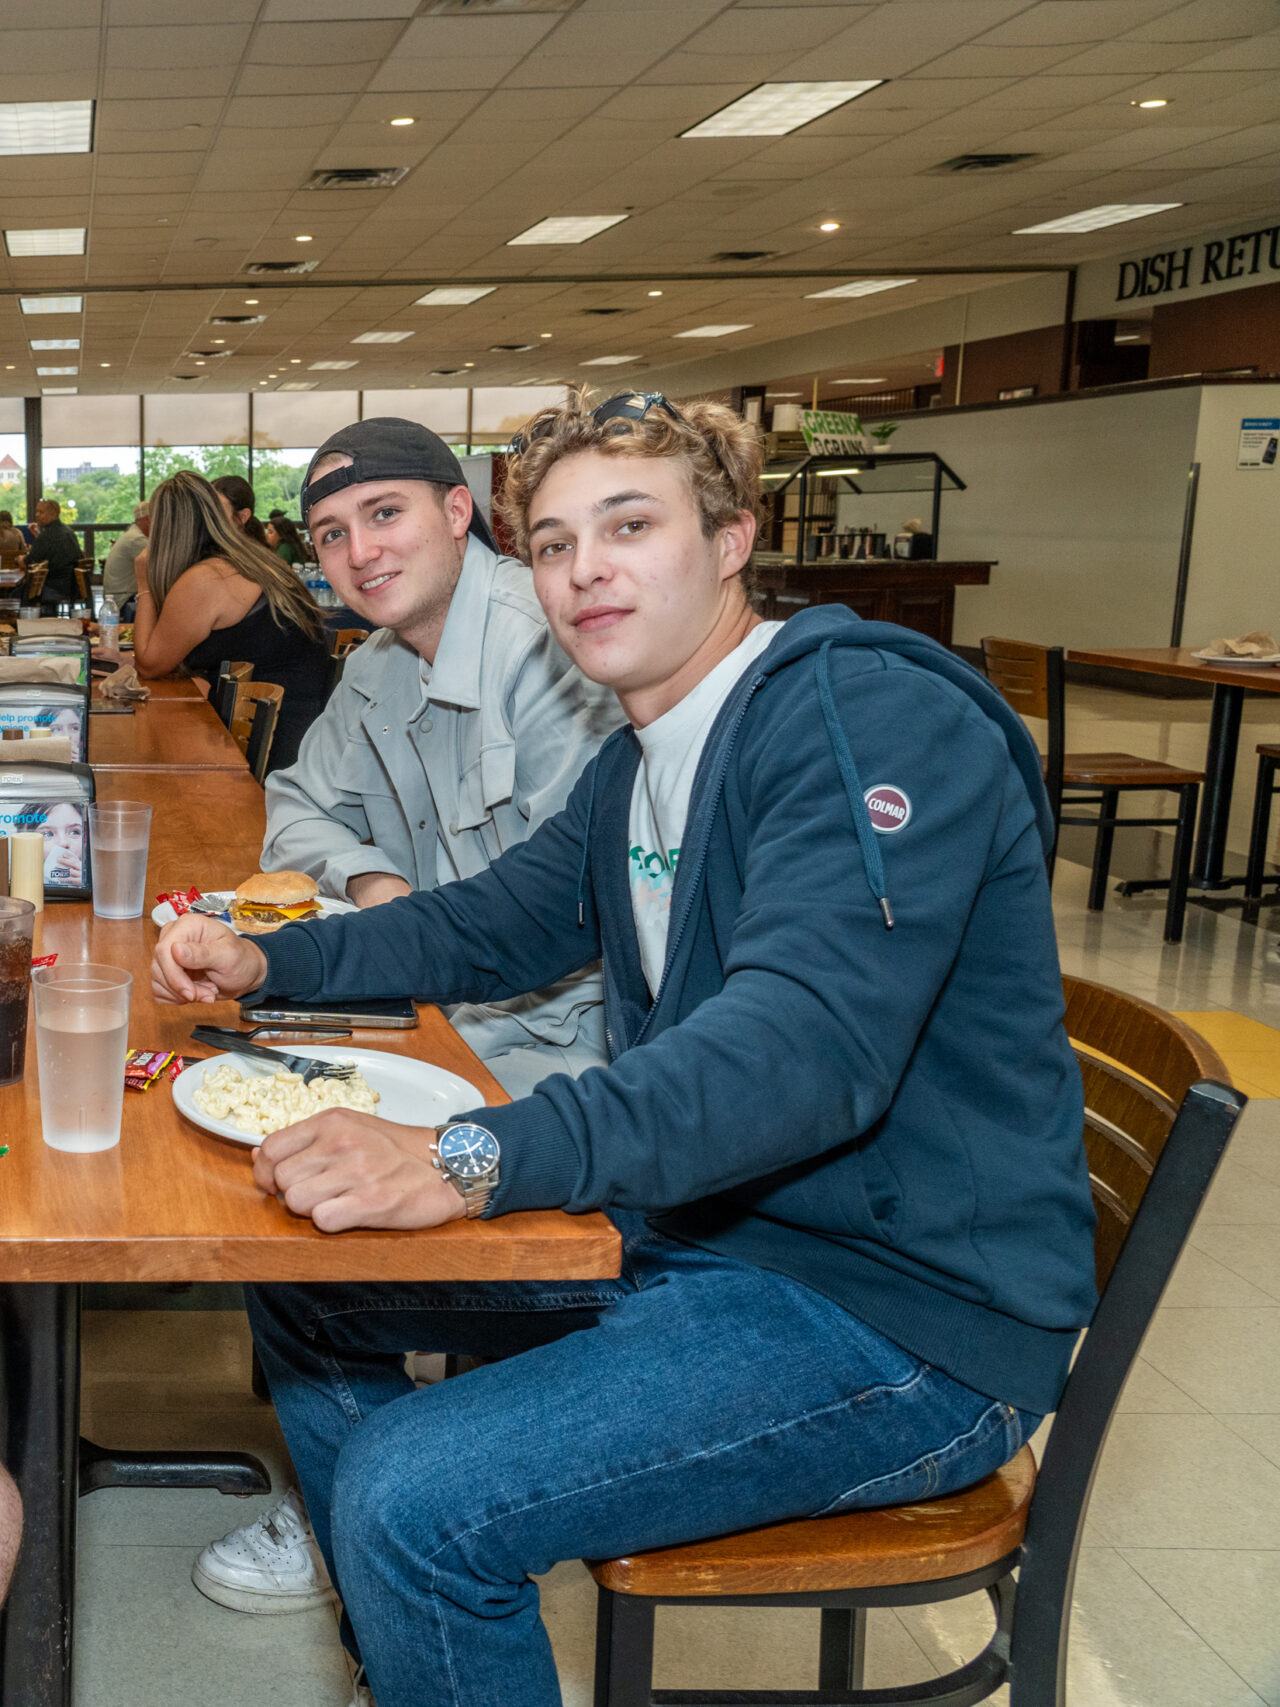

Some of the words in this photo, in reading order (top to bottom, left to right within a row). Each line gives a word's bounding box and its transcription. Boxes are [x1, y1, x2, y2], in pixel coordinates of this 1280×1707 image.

[1116, 247, 1193, 301] DISH
[805, 411, 860, 434] GREENS
[18, 713, 57, 723] promote
[868, 798, 906, 821] COLMAR
